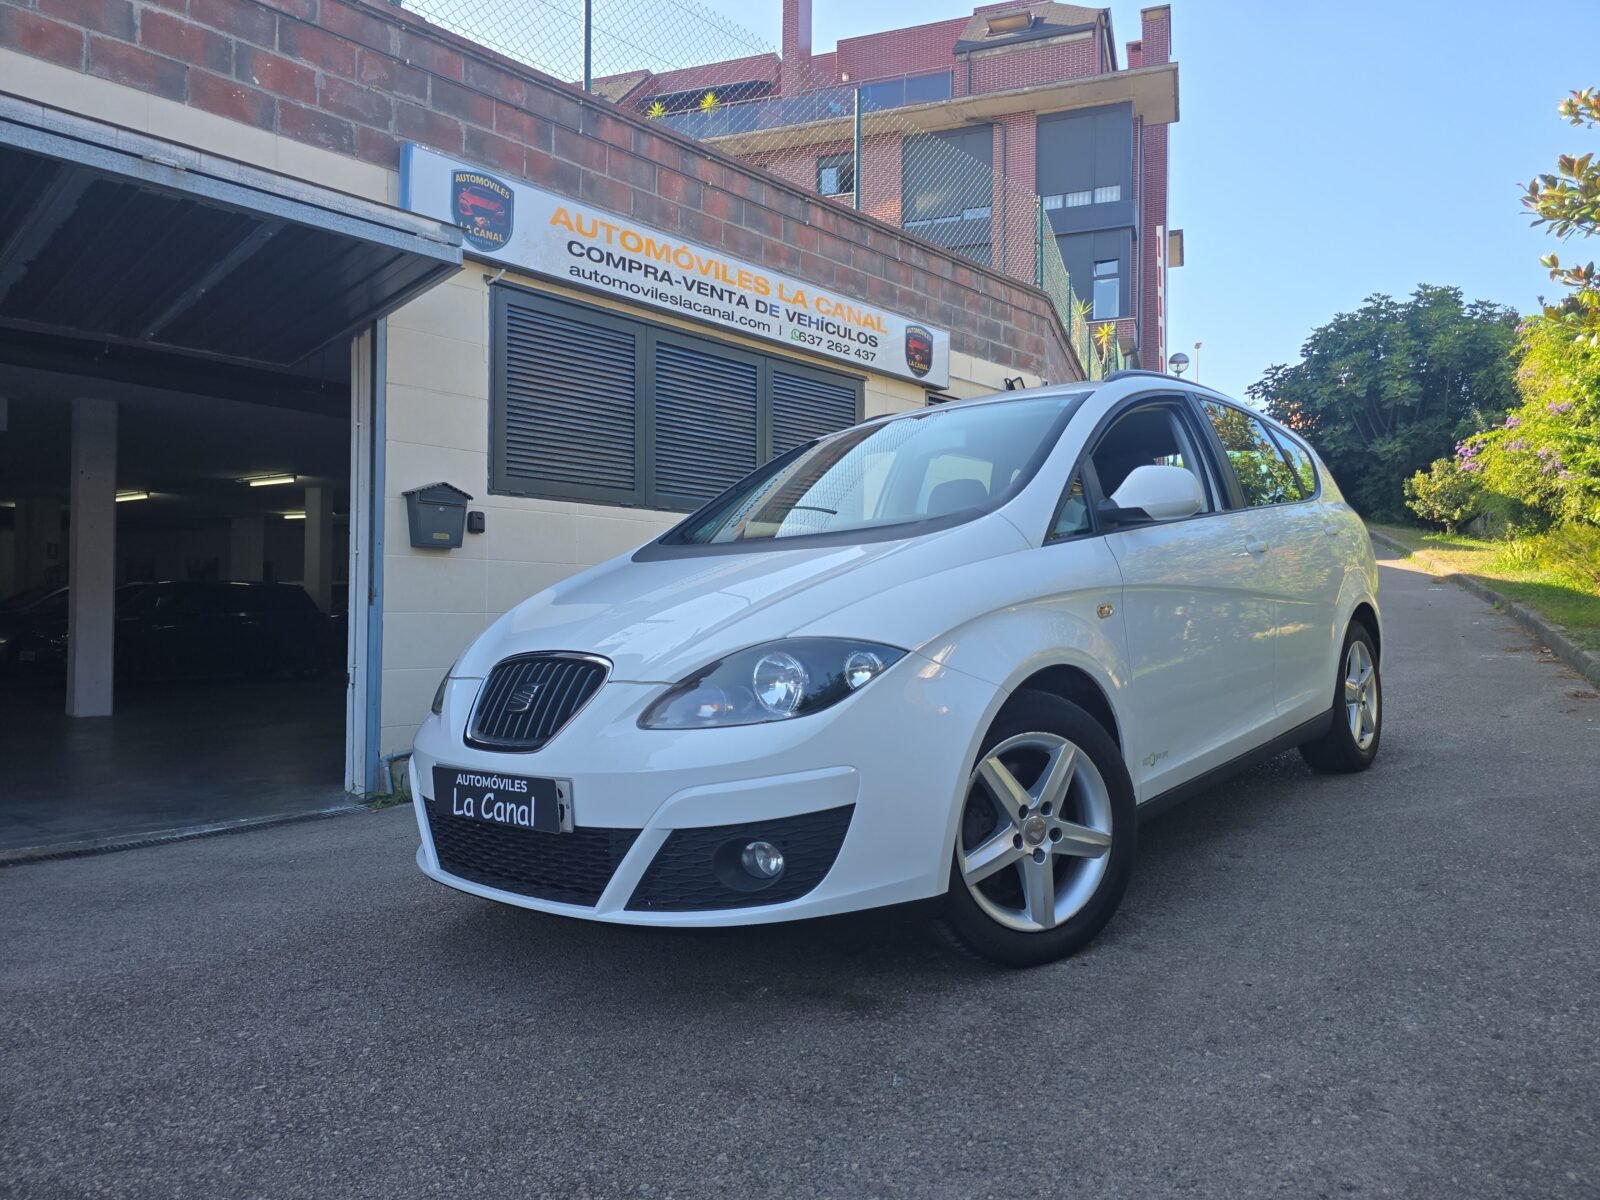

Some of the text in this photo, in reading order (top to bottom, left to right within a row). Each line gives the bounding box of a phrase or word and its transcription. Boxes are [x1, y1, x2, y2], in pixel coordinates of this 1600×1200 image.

[473, 227, 504, 242] CANAL
[550, 207, 888, 334] AUTOMÓVILES LA CANAL
[567, 240, 879, 348] COMPRA-VENTA DE VEHÍCULOS
[569, 265, 771, 332] automovileslacanal.com
[798, 333, 823, 347] 637
[827, 339, 850, 355] 262
[854, 348, 876, 362] 437
[453, 788, 535, 827] La Canal
[456, 773, 527, 793] AUTOMÓVILES
